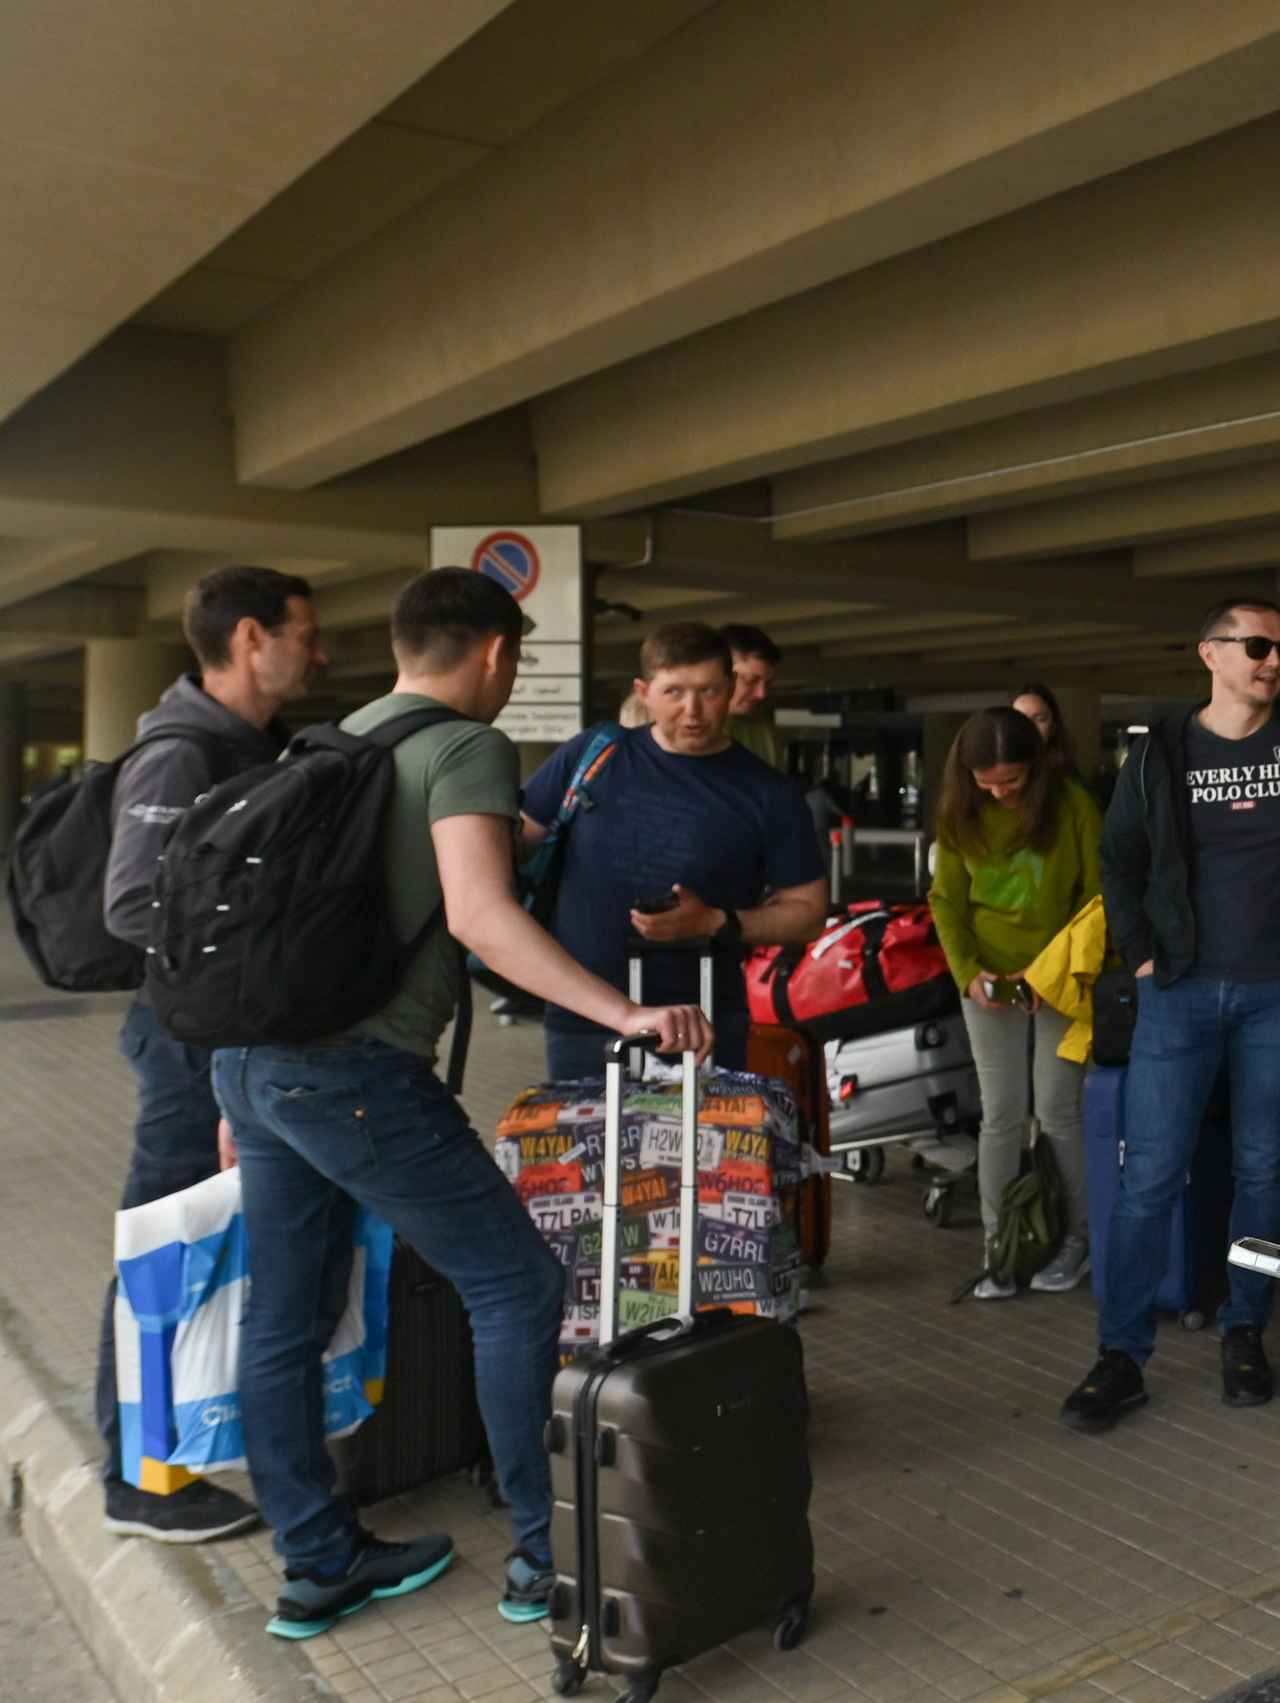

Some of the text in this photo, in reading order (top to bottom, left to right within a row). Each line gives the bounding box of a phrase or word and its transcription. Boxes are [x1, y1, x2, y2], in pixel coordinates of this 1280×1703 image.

[1186, 766, 1256, 786] EVERLY
[1191, 784, 1241, 803] POLO
[704, 1231, 766, 1263] G7RRL
[698, 1268, 755, 1293] W2UHQ
